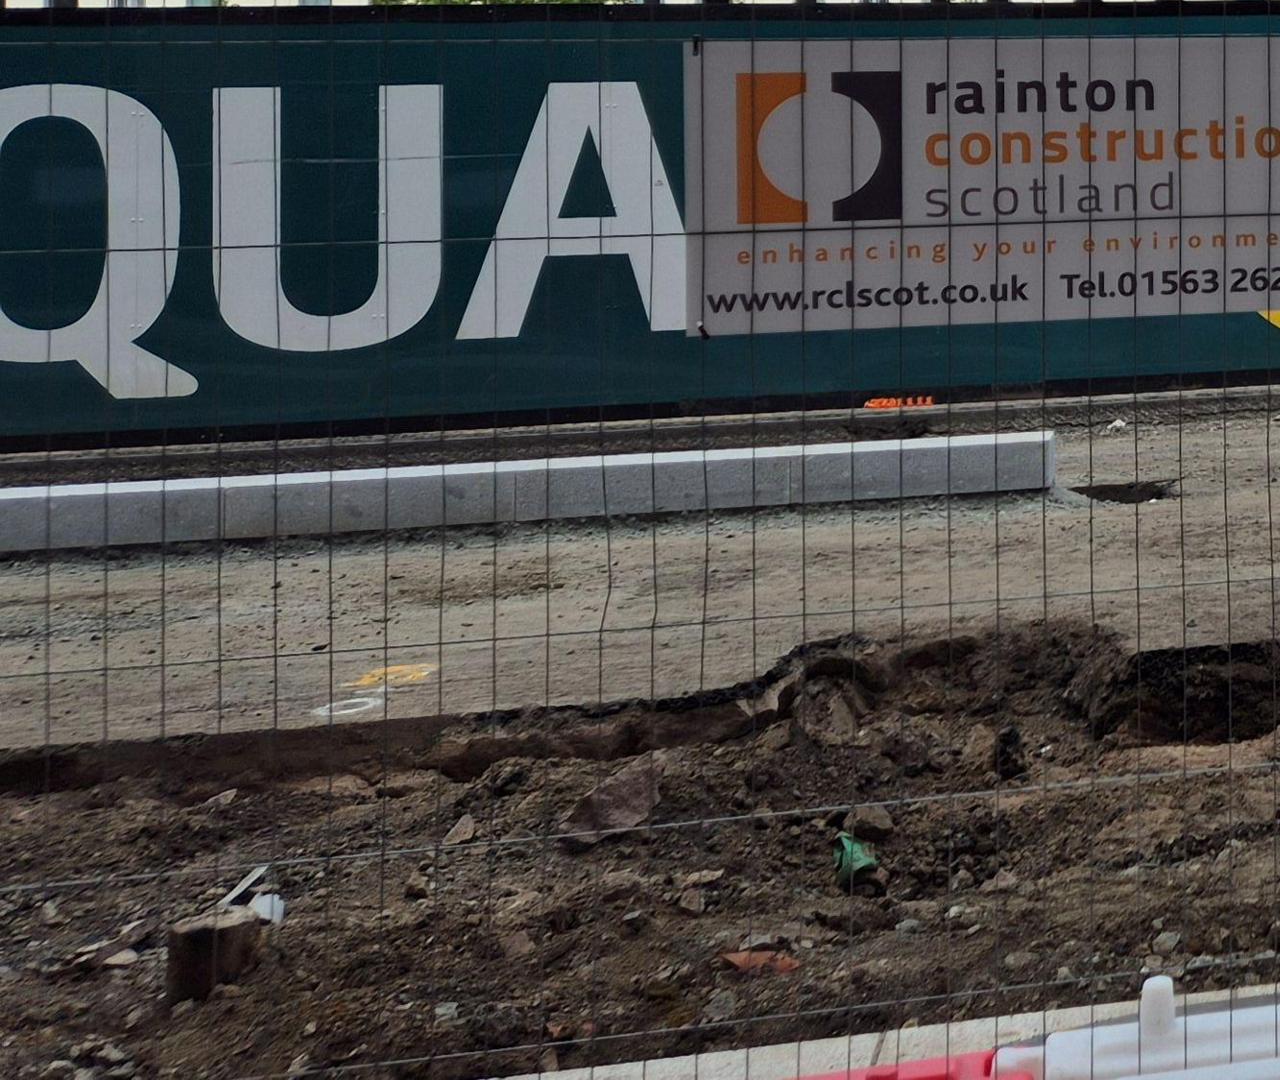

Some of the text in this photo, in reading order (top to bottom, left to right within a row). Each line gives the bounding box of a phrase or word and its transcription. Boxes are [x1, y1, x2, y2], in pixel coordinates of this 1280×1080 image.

[925, 69, 1156, 115] rainton
[925, 171, 1175, 218] scotland
[737, 240, 947, 265] enhancing
[971, 238, 1058, 262] your
[706, 274, 1029, 315] www.rclscot.co.uk
